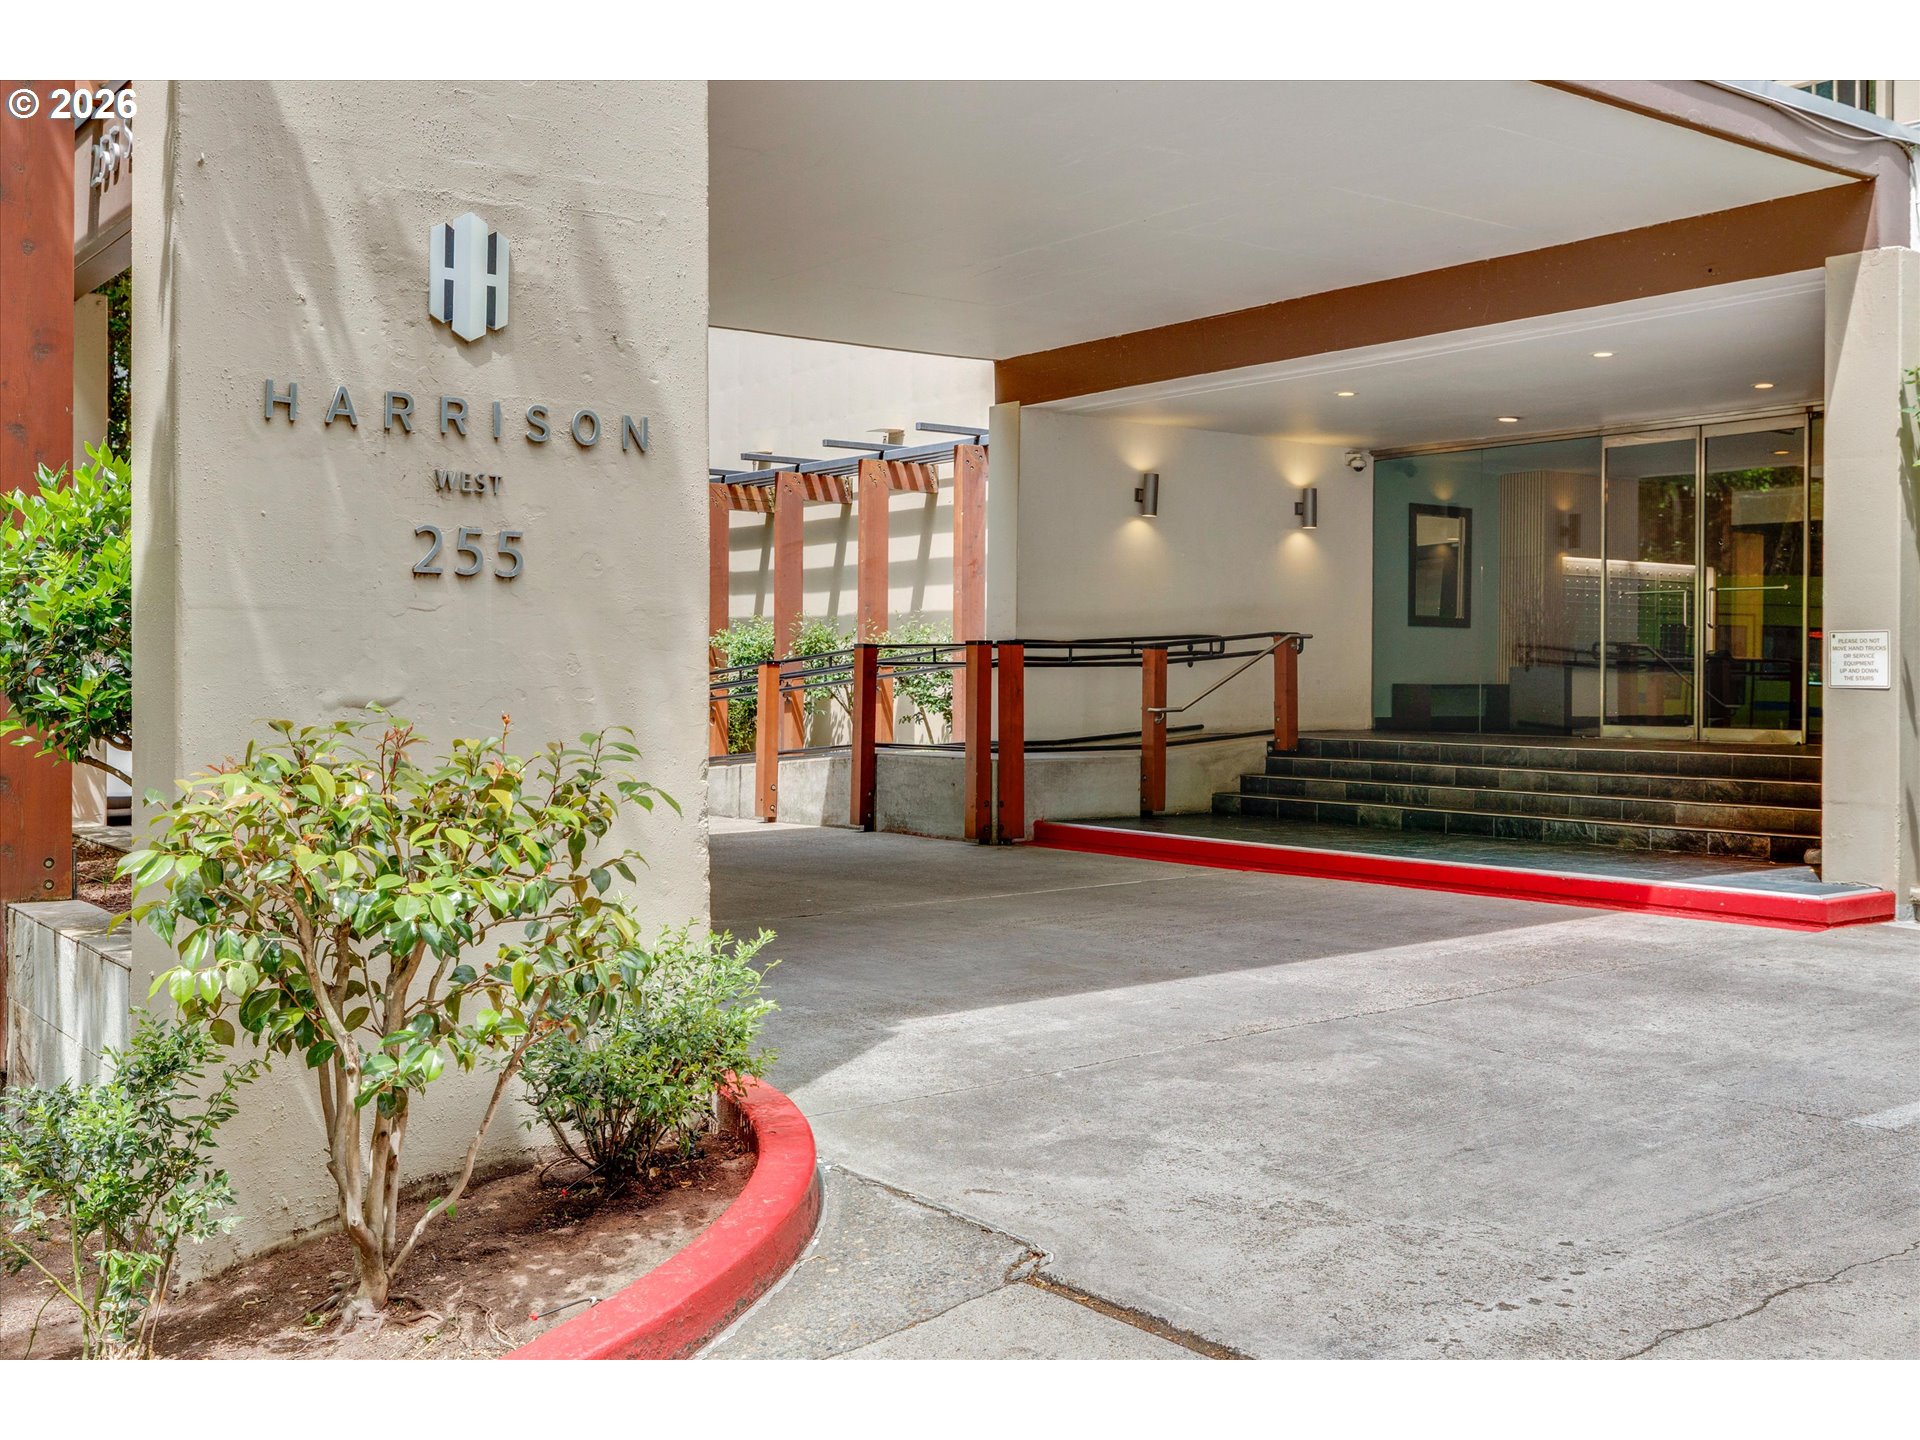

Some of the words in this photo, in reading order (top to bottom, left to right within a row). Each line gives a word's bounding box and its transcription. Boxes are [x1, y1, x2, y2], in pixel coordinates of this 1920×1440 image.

[265, 378, 649, 453] HARRISON
[434, 469, 503, 496] WEST
[411, 524, 524, 579] 255
